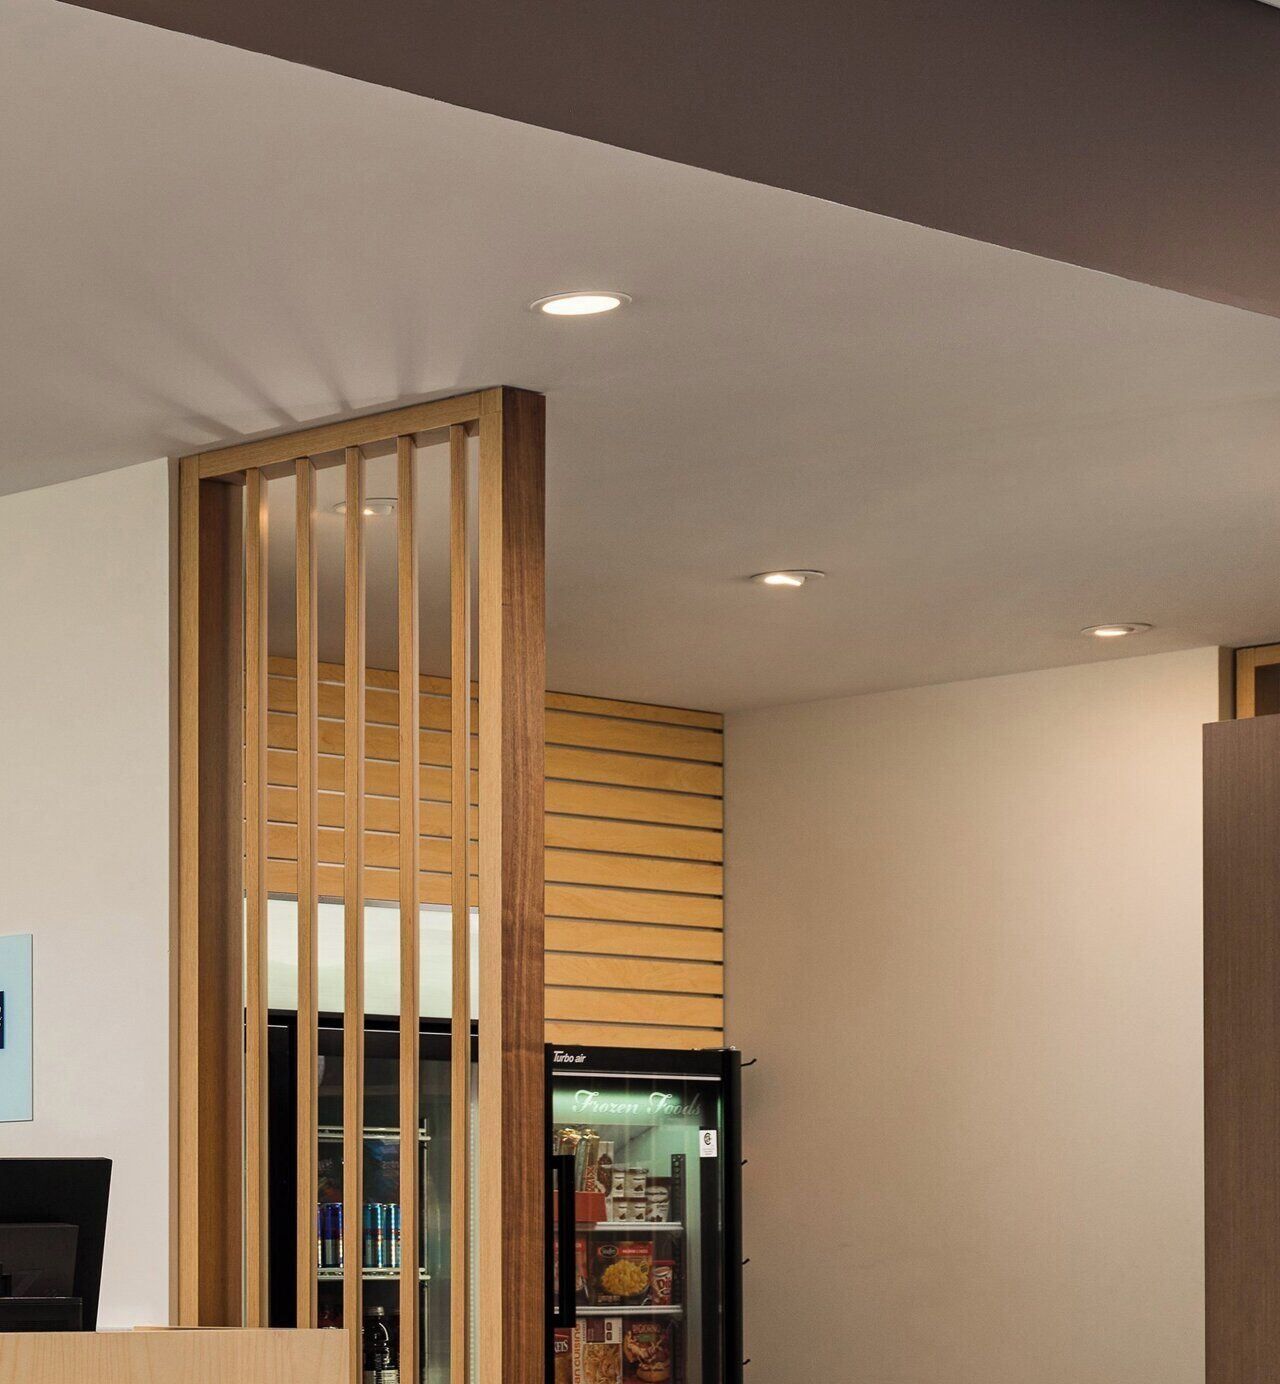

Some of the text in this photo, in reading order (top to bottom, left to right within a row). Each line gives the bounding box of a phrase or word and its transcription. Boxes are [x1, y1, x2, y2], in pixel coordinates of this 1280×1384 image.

[553, 1050, 587, 1063] Turbo air
[572, 1089, 702, 1116] Frozen Foods
